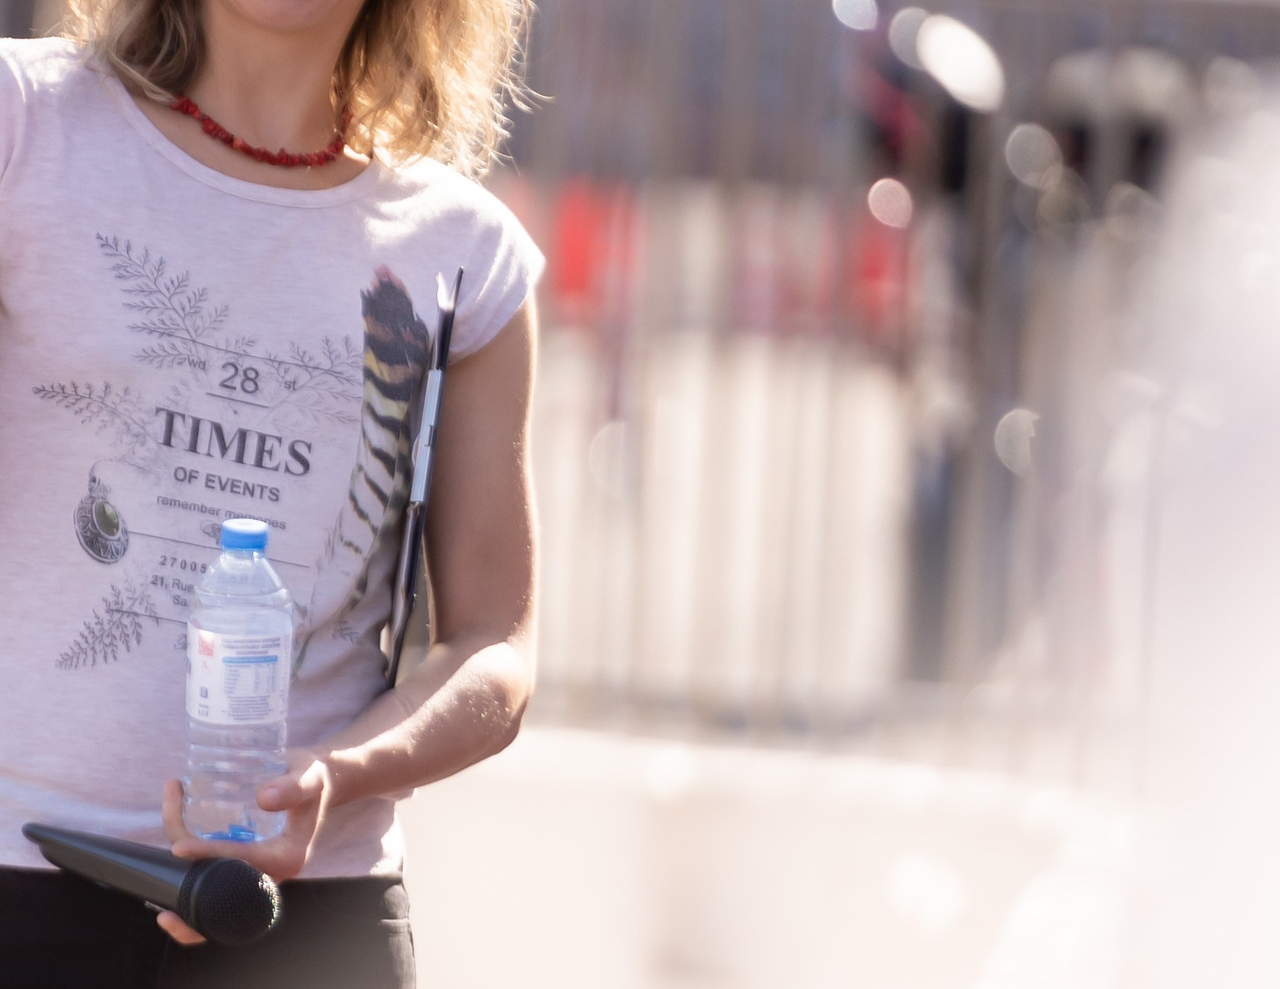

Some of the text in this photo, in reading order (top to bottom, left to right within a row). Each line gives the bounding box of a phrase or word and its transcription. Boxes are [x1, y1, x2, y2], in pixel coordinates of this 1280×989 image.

[219, 362, 260, 394] 28
[155, 407, 312, 477] TIMES
[173, 466, 280, 502] OF EVENTS
[157, 495, 222, 516] remember
